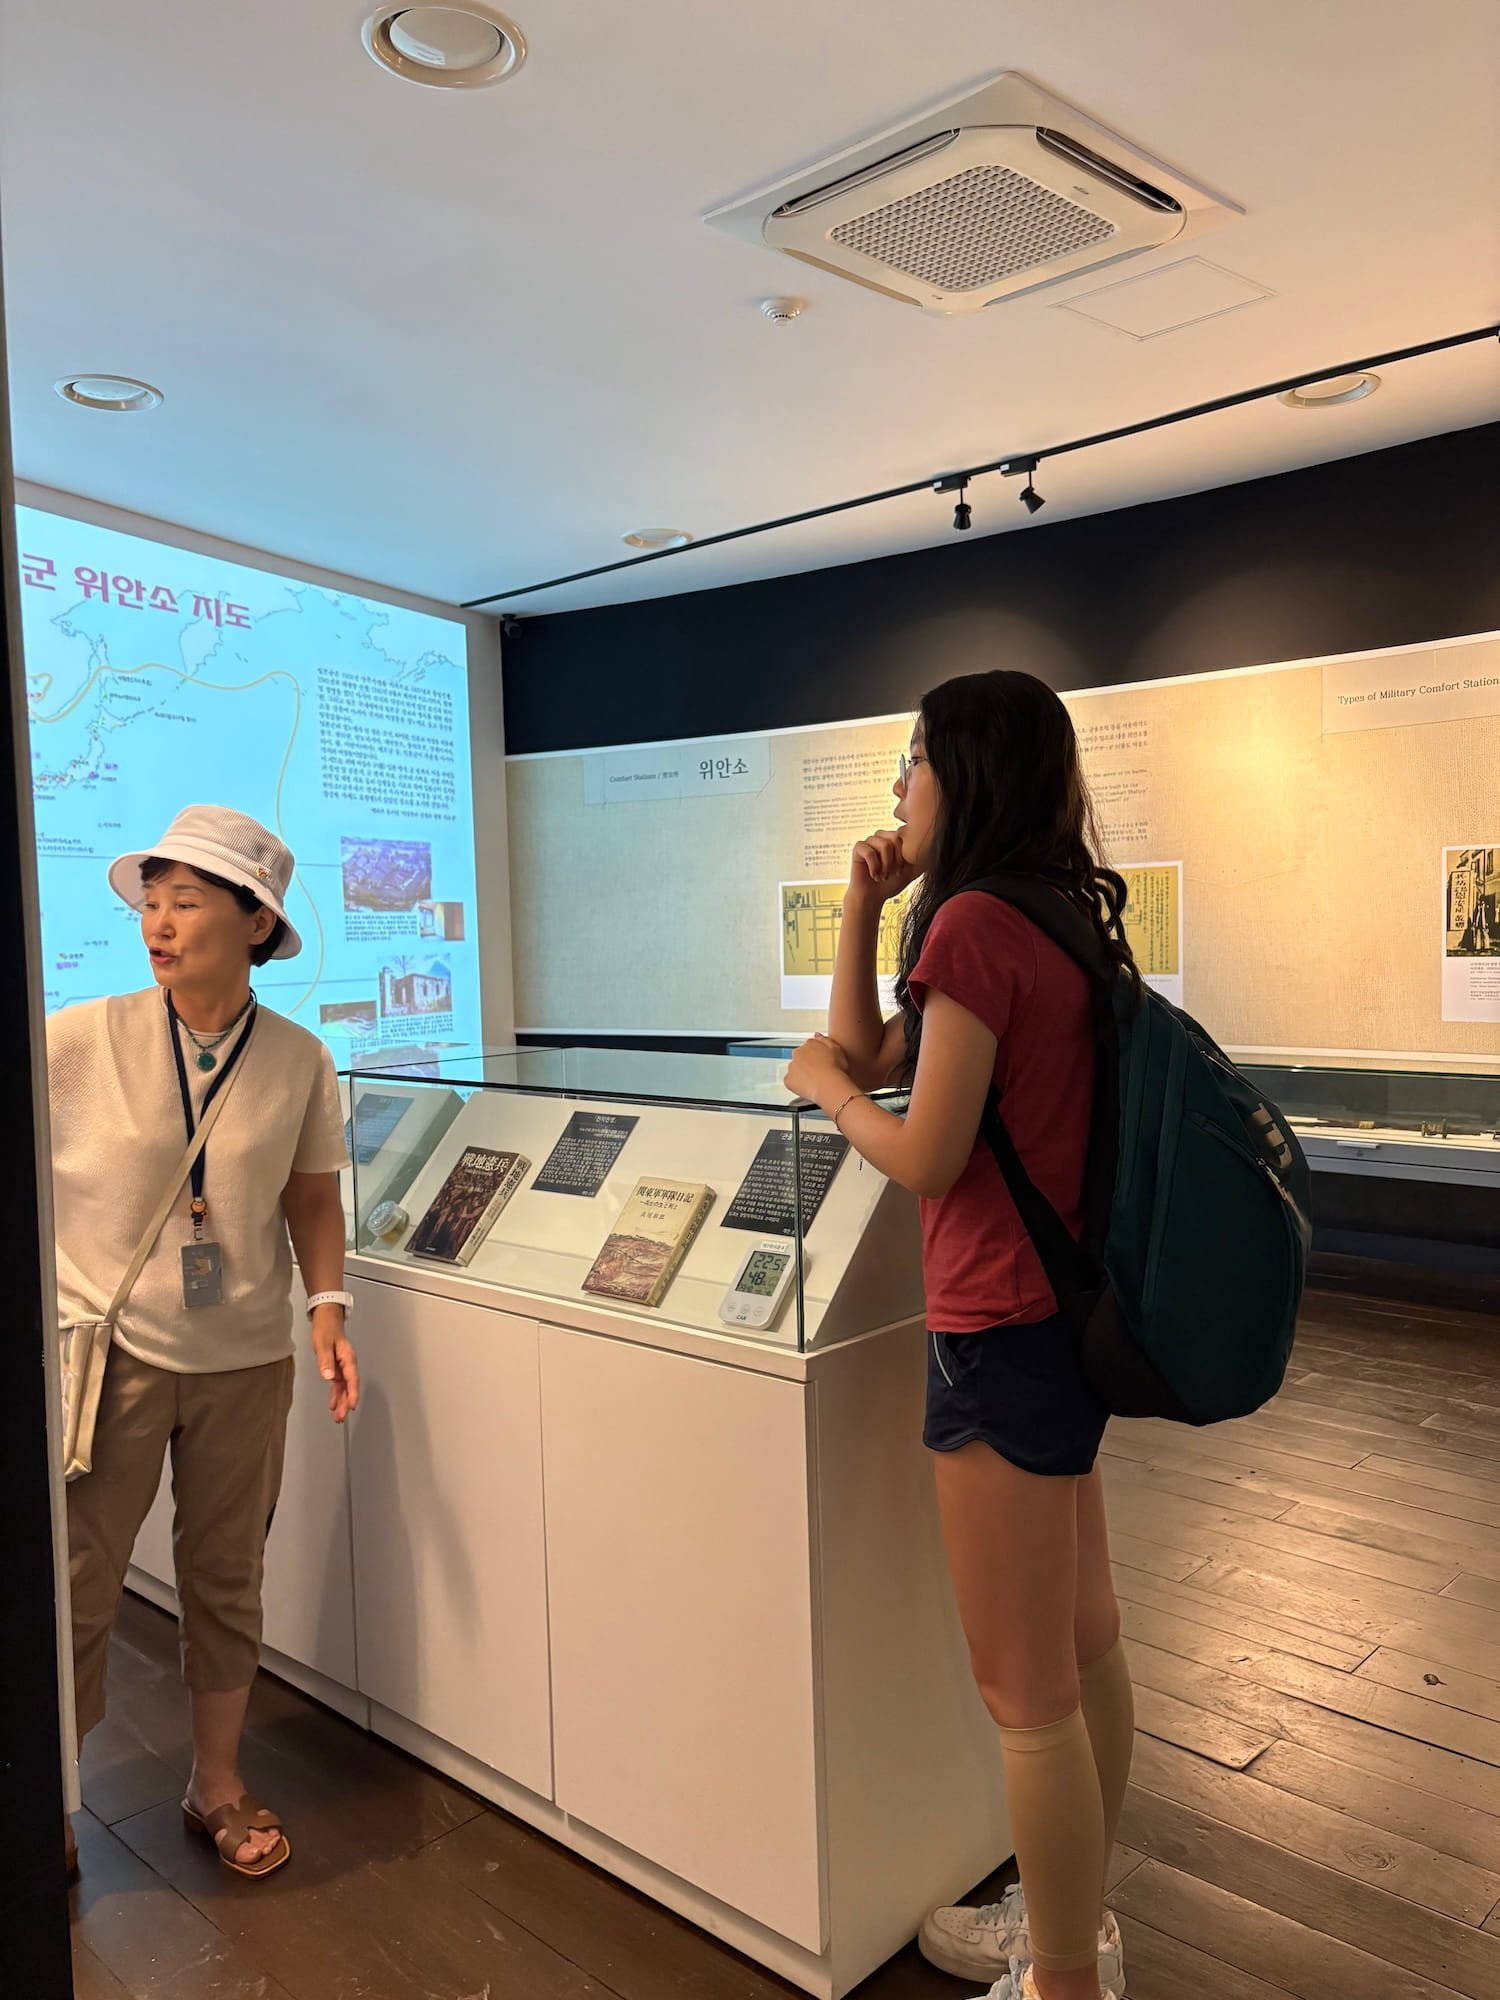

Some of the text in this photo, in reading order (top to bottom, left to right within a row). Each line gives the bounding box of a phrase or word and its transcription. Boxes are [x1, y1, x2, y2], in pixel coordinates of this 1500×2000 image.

[21, 553, 252, 629] 군 위안소 지도
[1338, 677, 1499, 705] Types of Military Comfort Station
[609, 775, 632, 783] Comfort
[699, 758, 749, 780] 위안소
